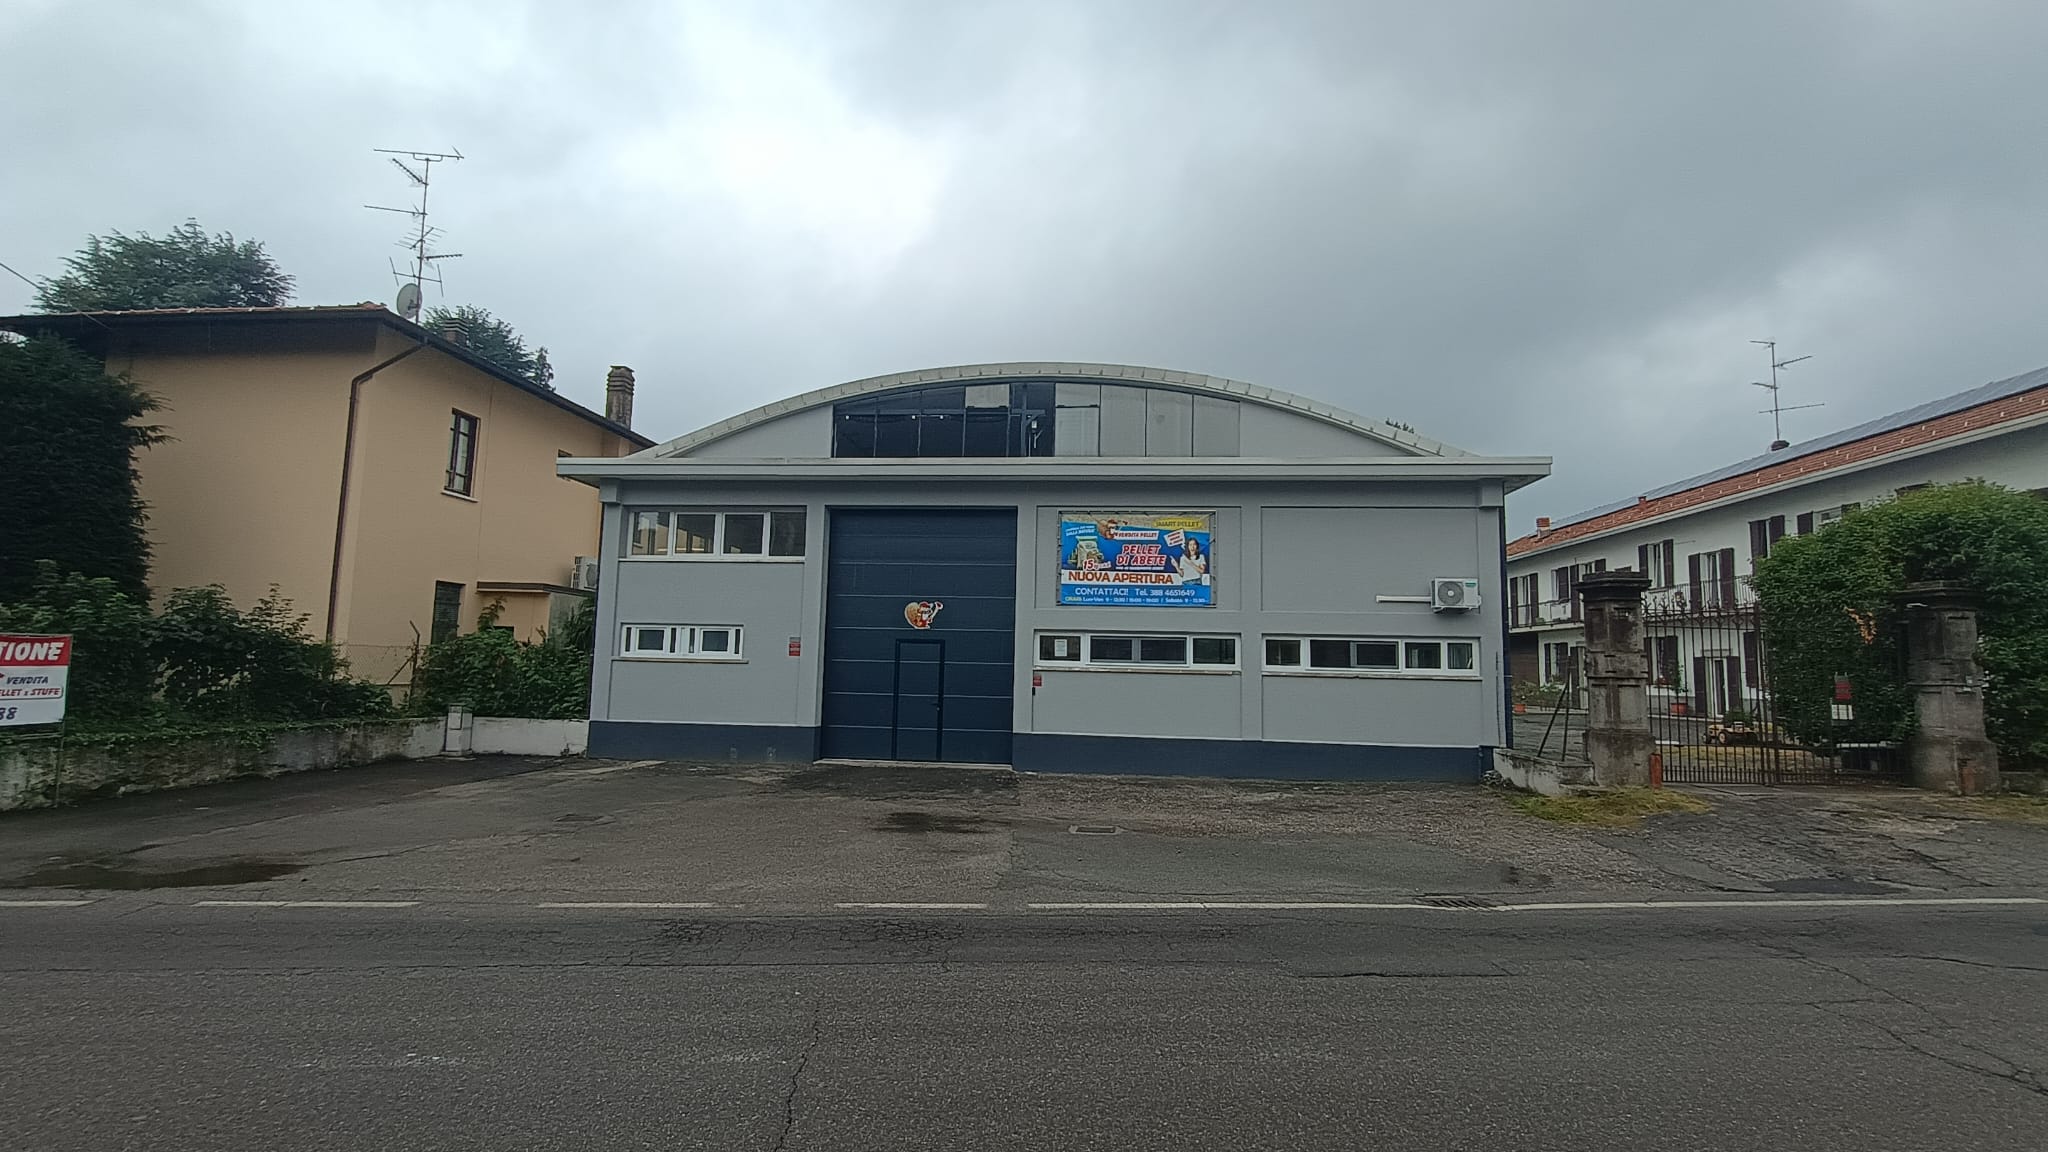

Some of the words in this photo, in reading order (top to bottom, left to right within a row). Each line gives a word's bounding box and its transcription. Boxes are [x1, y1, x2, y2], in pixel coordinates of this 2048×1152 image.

[1123, 545, 1161, 555] PELLET
[1083, 559, 1094, 570] 15
[1117, 555, 1129, 565] DI
[1132, 555, 1166, 565] ABETE
[1068, 571, 1110, 582] NUOVA
[1112, 573, 1173, 584] APERTURA
[7, 676, 49, 685] VENDITA
[30, 688, 61, 696] STUFE
